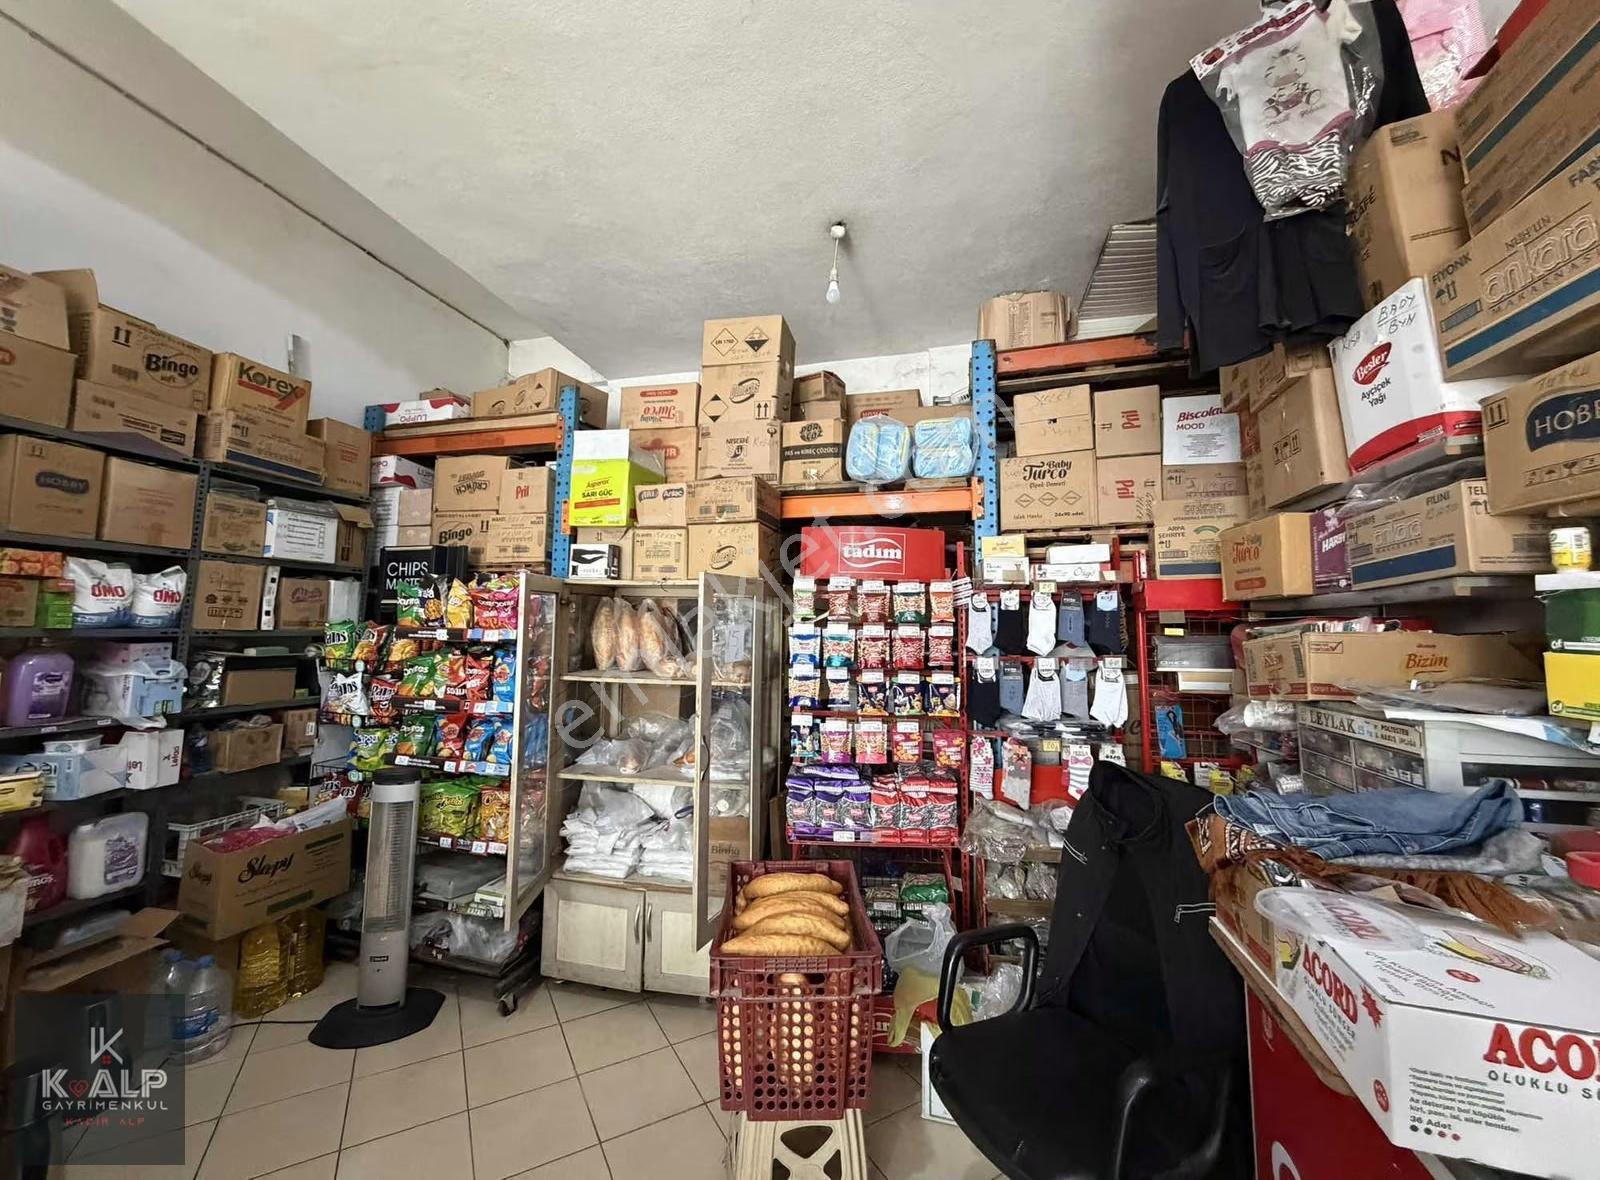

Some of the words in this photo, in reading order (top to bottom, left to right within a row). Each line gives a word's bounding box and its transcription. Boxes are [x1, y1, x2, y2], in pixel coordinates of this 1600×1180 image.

[1484, 214, 1598, 303] ankara
[145, 353, 198, 378] Bingo
[1355, 350, 1388, 380] Besler
[238, 361, 301, 399] Korex
[1361, 377, 1392, 401] Ayçiçek
[1368, 393, 1387, 408] Yağı
[1121, 409, 1141, 430] Pril
[1177, 406, 1225, 423] Biscola
[1176, 422, 1205, 431] MOOD
[1022, 461, 1068, 481] Turco
[1047, 460, 1073, 471] Baby
[515, 484, 530, 500] Pril
[598, 488, 613, 497] GÜÇ
[1115, 479, 1136, 500] Pril
[438, 526, 473, 545] Bingo
[842, 543, 902, 560] tadım
[387, 562, 429, 577] CHIPS
[91, 582, 126, 598] OMO
[1405, 653, 1449, 670] Bizim
[1310, 709, 1357, 735] LEYLAK
[1302, 943, 1358, 1025] ACORD
[1483, 1023, 1600, 1081] ACO
[1488, 1069, 1569, 1095] OLUKLU
[1426, 1119, 1452, 1130] Adet
